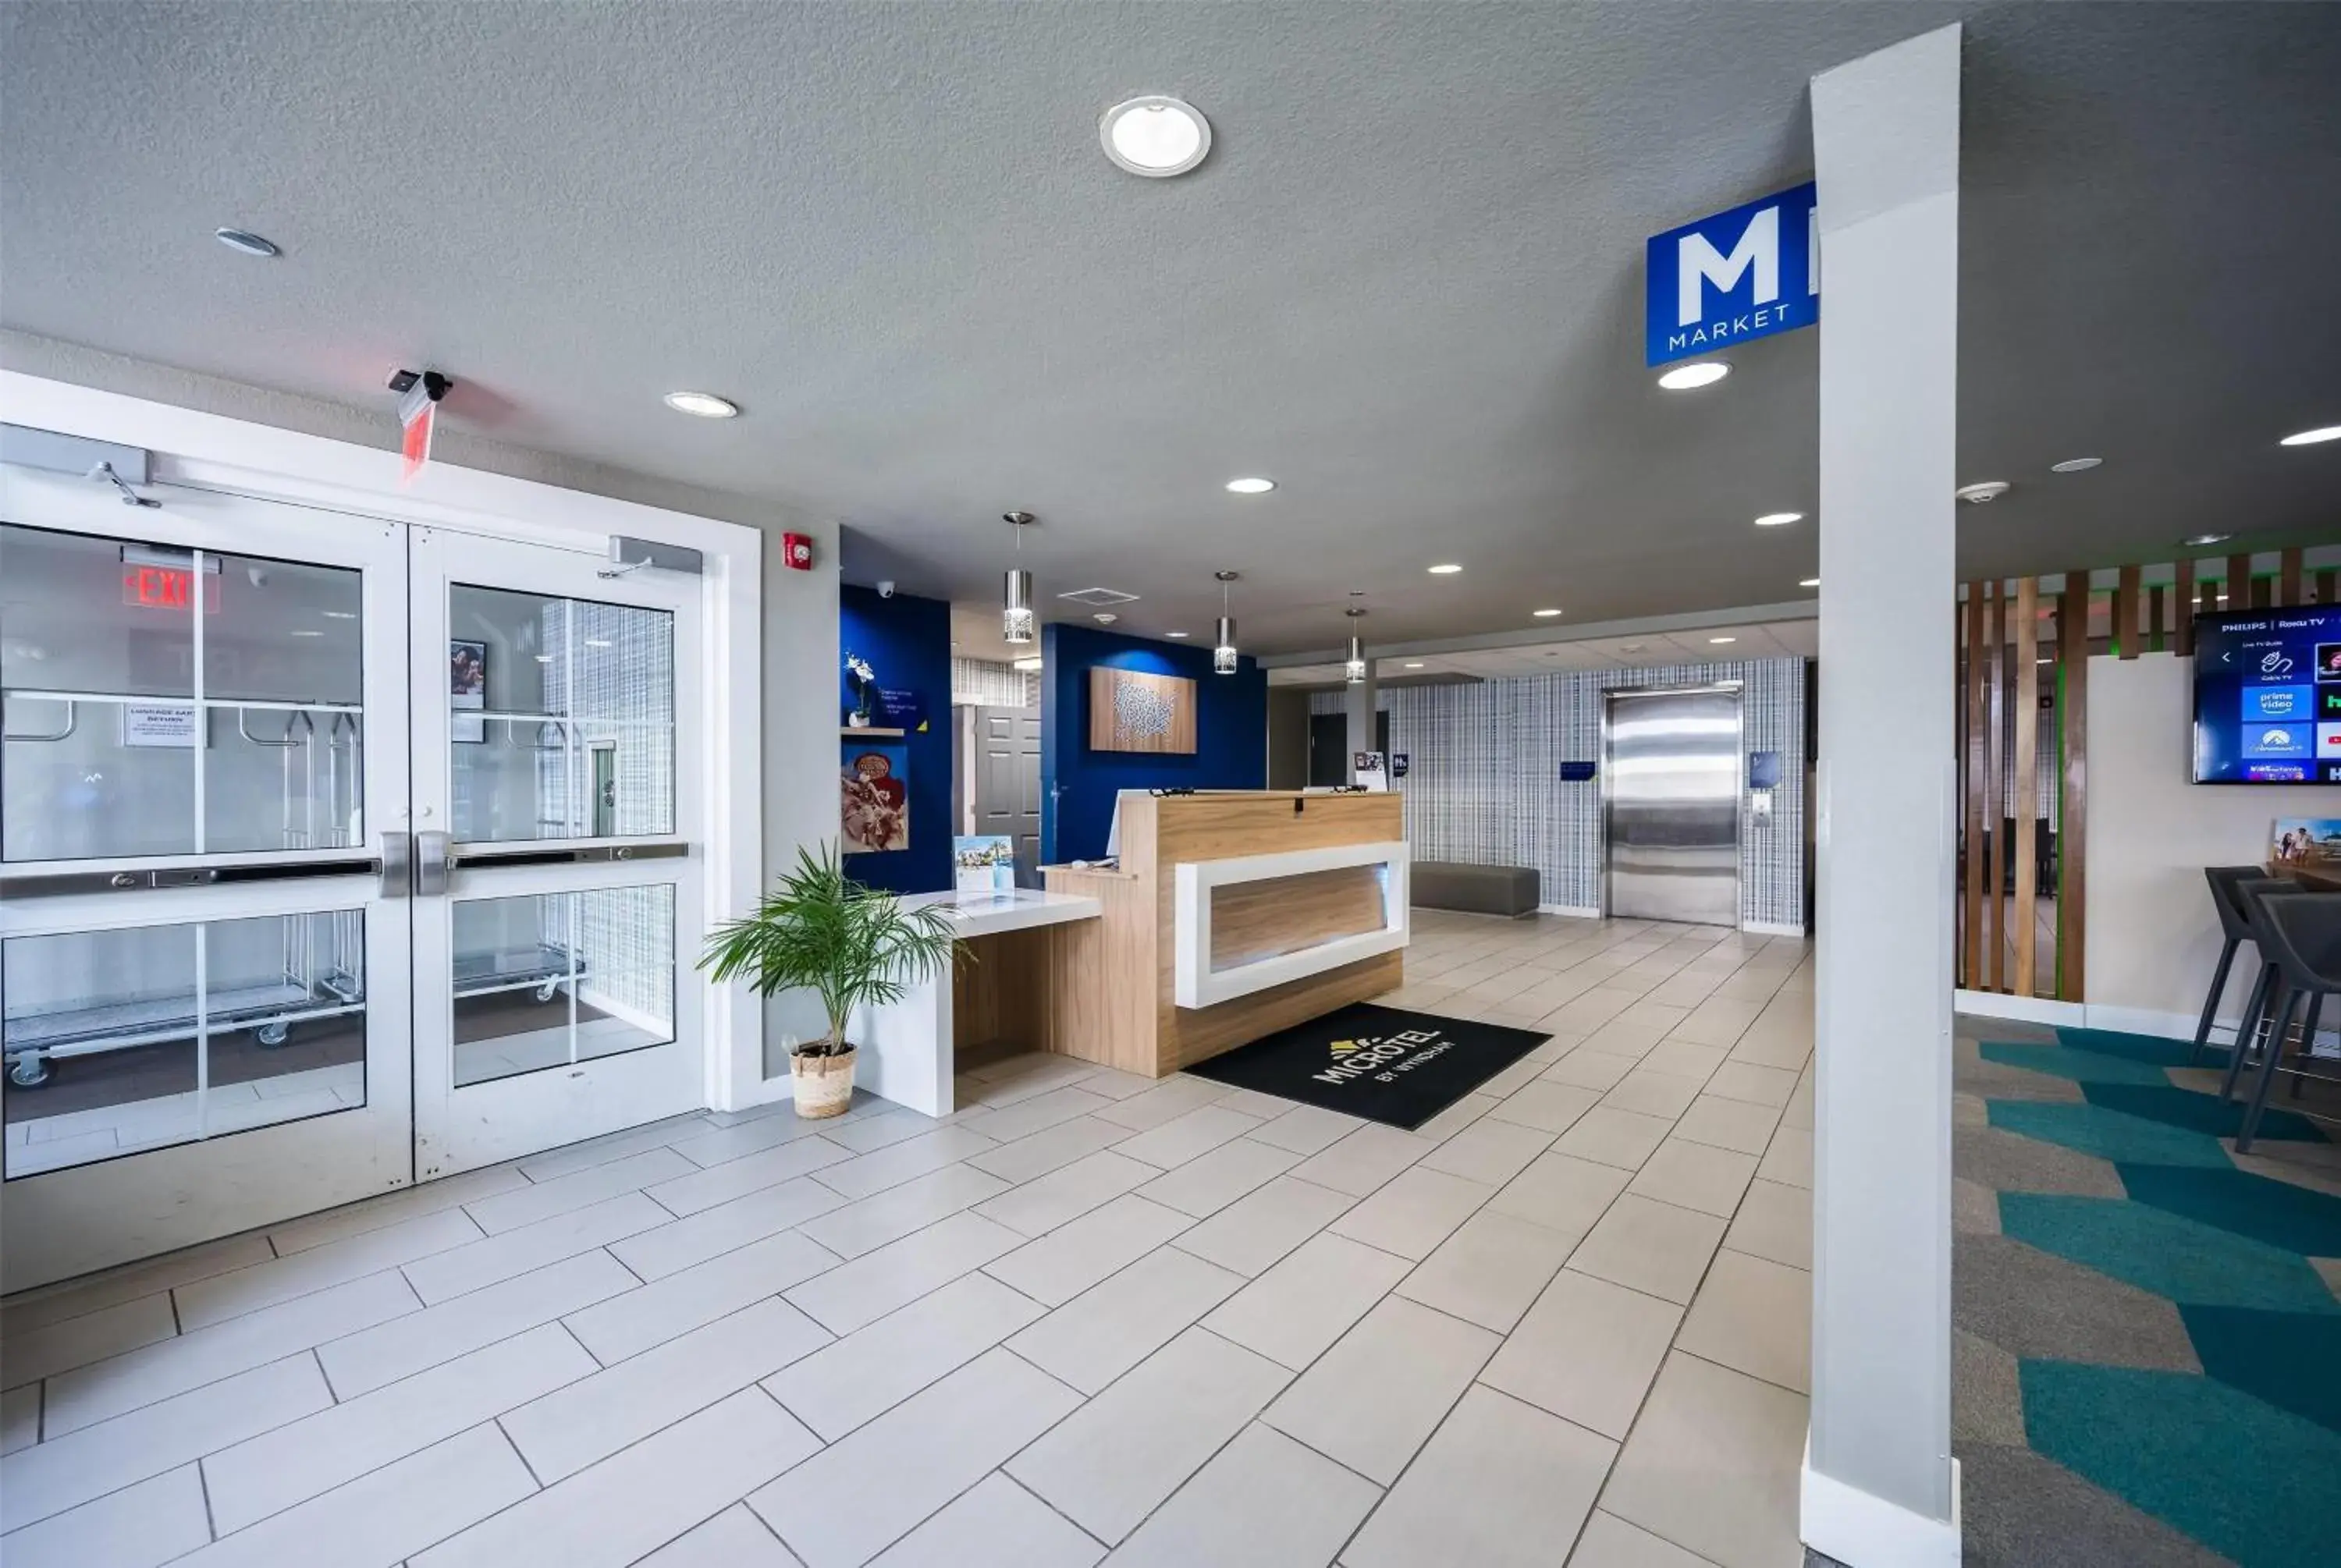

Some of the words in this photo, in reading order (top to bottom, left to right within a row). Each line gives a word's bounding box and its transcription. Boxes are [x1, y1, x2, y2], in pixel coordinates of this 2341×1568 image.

[1678, 205, 1779, 328] M
[1668, 303, 1791, 353] MARKET
[2222, 621, 2267, 633] PHILIPS
[2309, 617, 2325, 626] TV
[2260, 692, 2294, 701] prime
[2261, 701, 2293, 709] video
[1311, 1030, 1442, 1085] MICROTEL
[1374, 1070, 1399, 1083] BY
